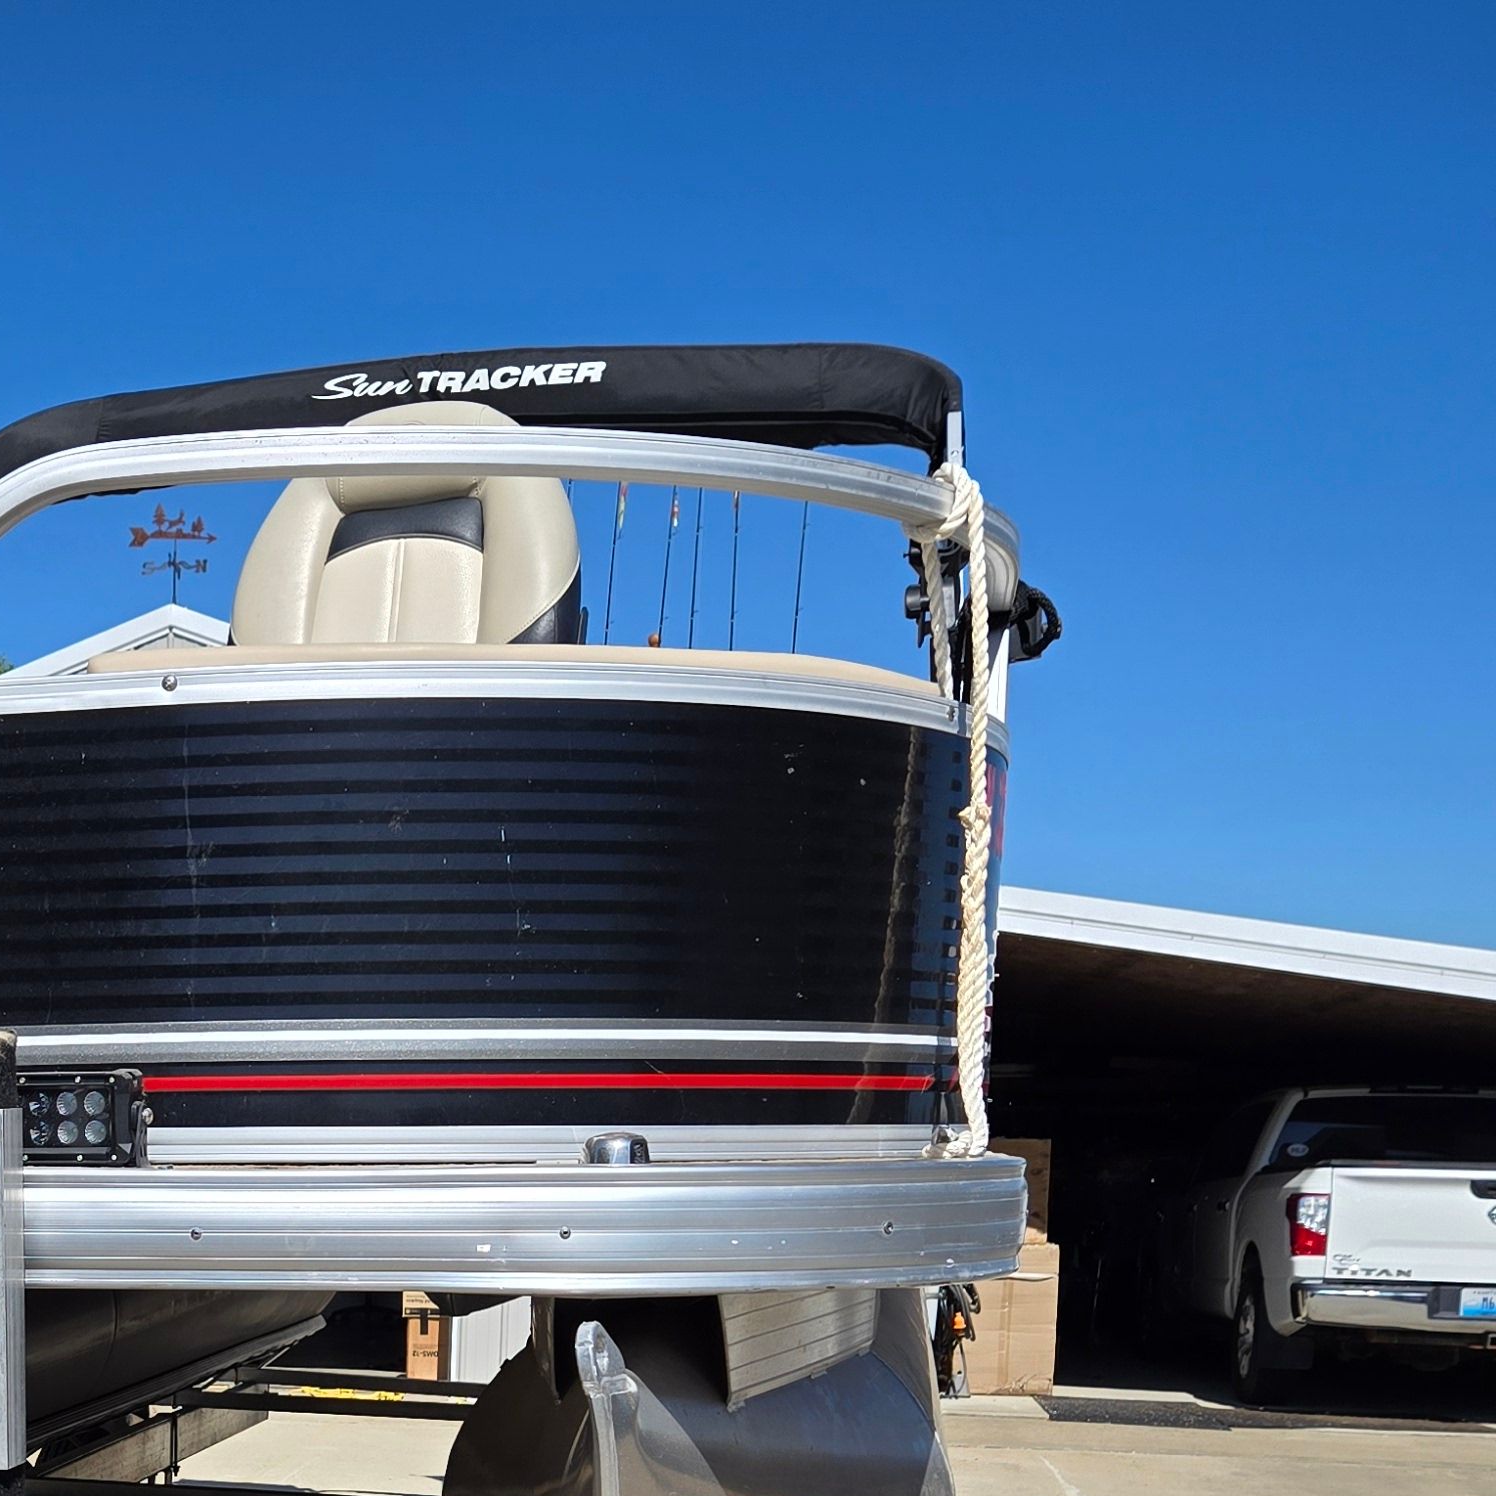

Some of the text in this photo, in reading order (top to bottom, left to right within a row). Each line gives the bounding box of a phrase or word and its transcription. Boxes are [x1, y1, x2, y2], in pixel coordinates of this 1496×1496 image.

[311, 360, 607, 400] Sun TRACKER
[1332, 1266, 1412, 1278] TITAN
